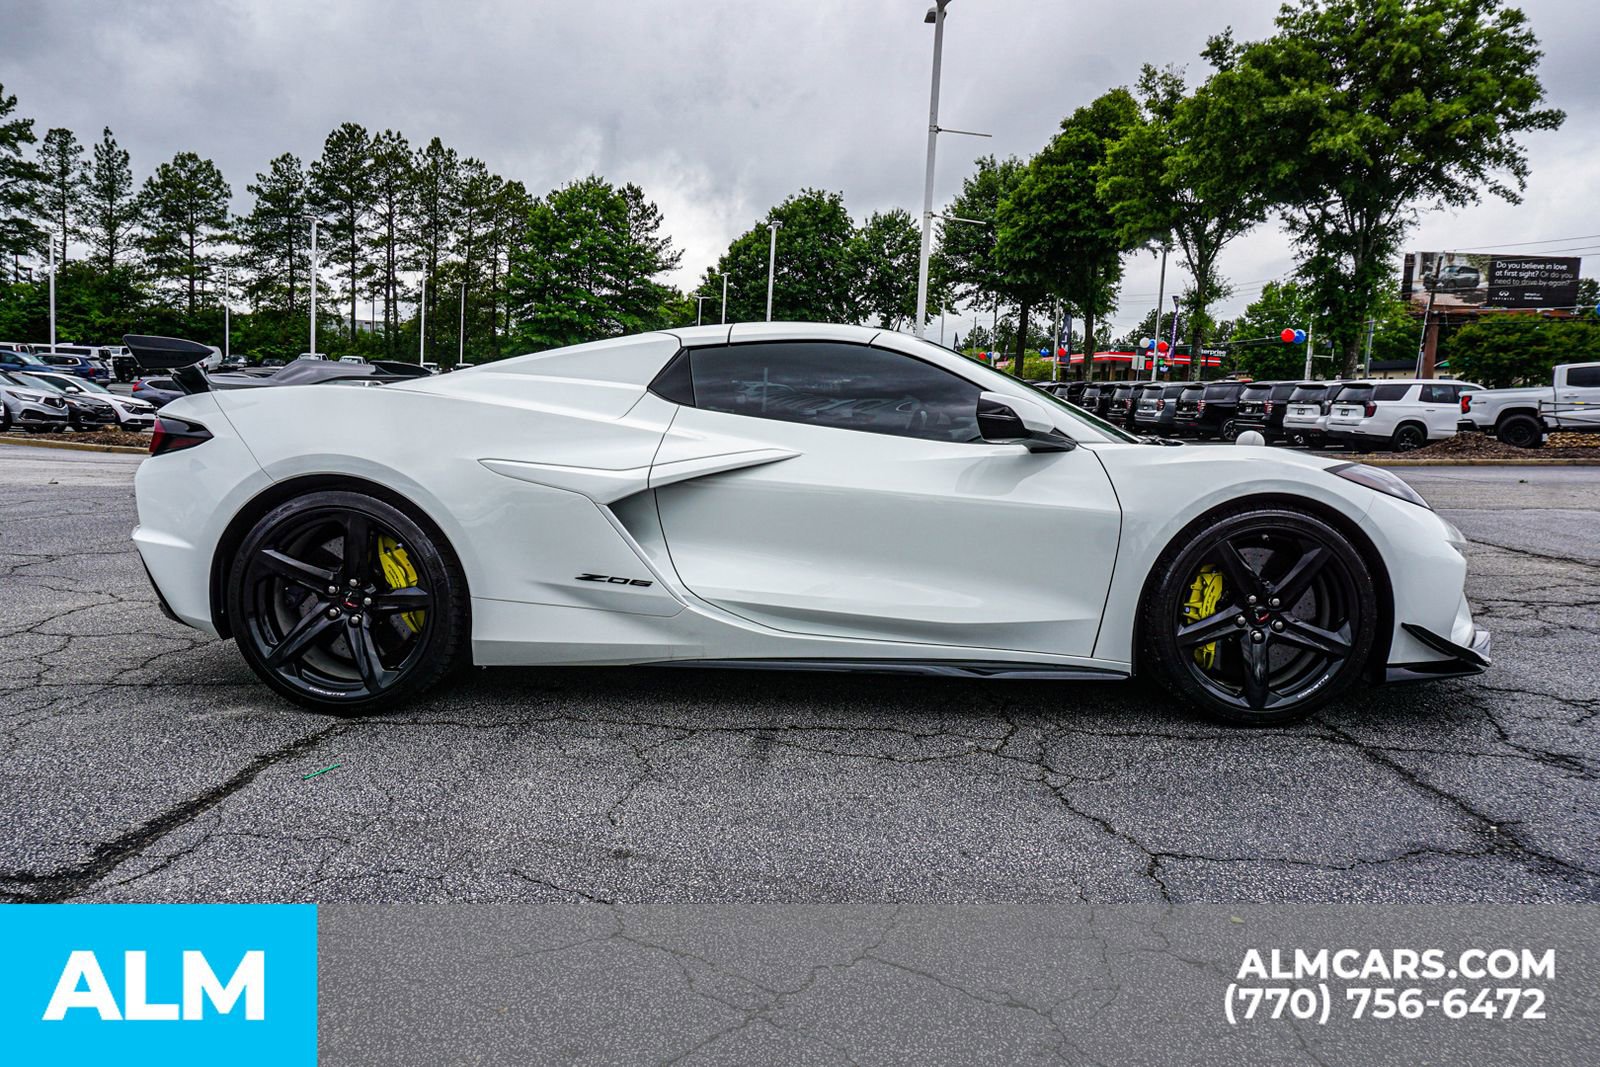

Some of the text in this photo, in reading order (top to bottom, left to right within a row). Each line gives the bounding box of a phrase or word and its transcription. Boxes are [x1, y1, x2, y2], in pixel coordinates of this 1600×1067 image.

[1496, 261, 1568, 271] Do you believe in love
[1519, 270, 1540, 279] sight?
[1550, 271, 1560, 279] do
[1547, 280, 1570, 288] again?
[574, 573, 654, 588] Z06
